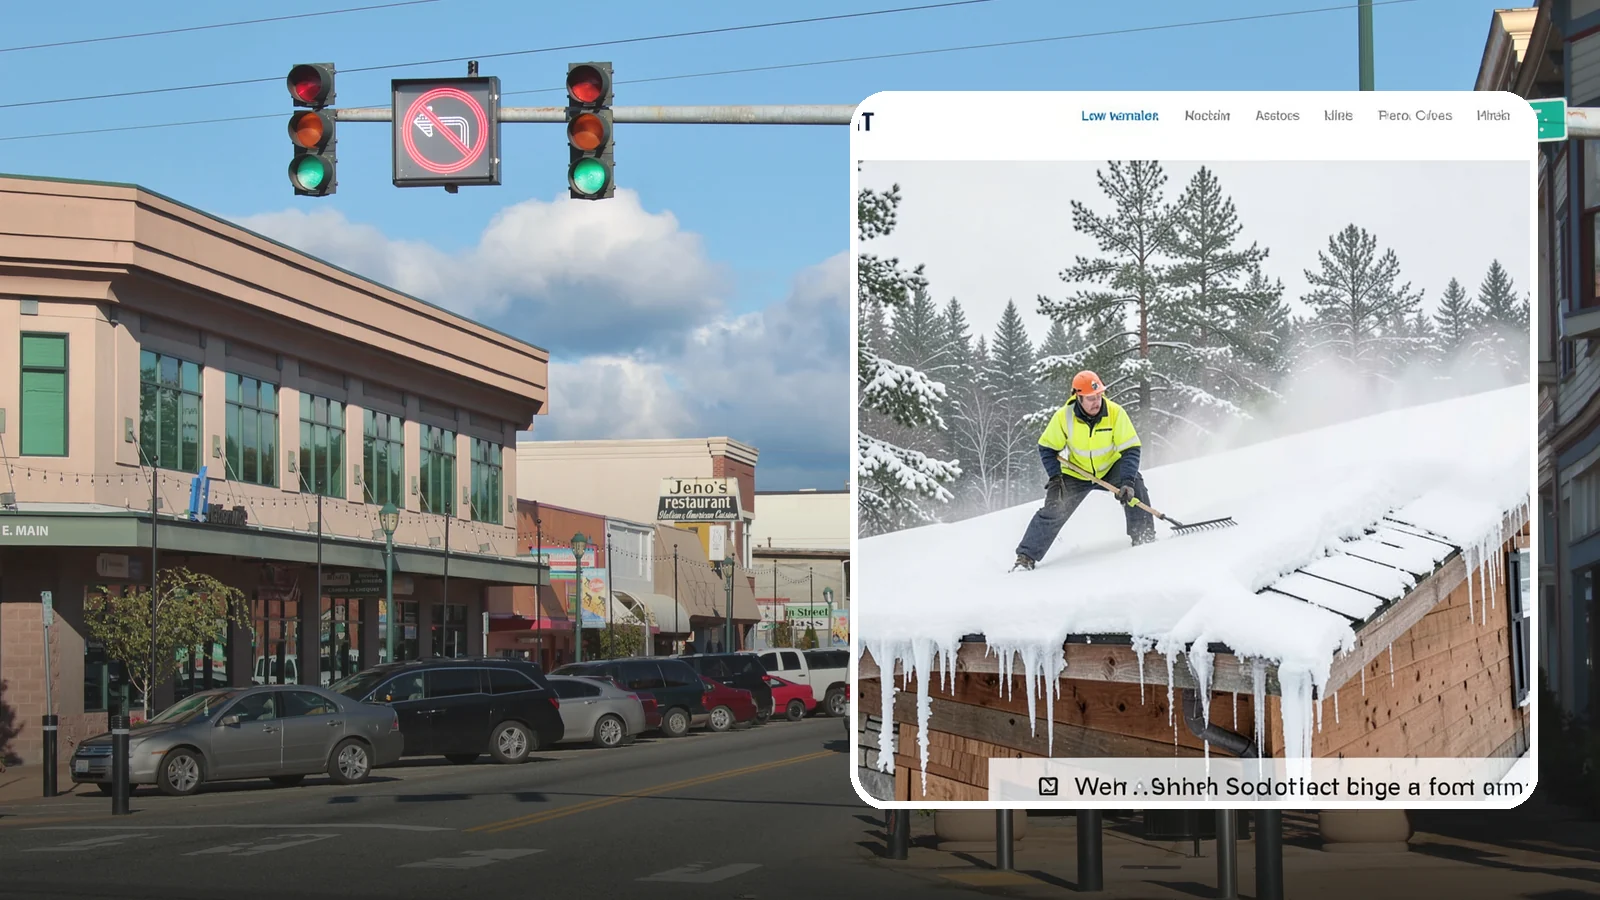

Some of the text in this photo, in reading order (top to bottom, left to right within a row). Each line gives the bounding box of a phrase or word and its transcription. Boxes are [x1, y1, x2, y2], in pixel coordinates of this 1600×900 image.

[669, 480, 728, 495] Jeno's
[665, 496, 731, 509] restaurant
[686, 510, 714, 520] American
[715, 509, 738, 520] Cuisine
[2, 525, 49, 536] E. MAIN
[797, 607, 829, 617] Street
